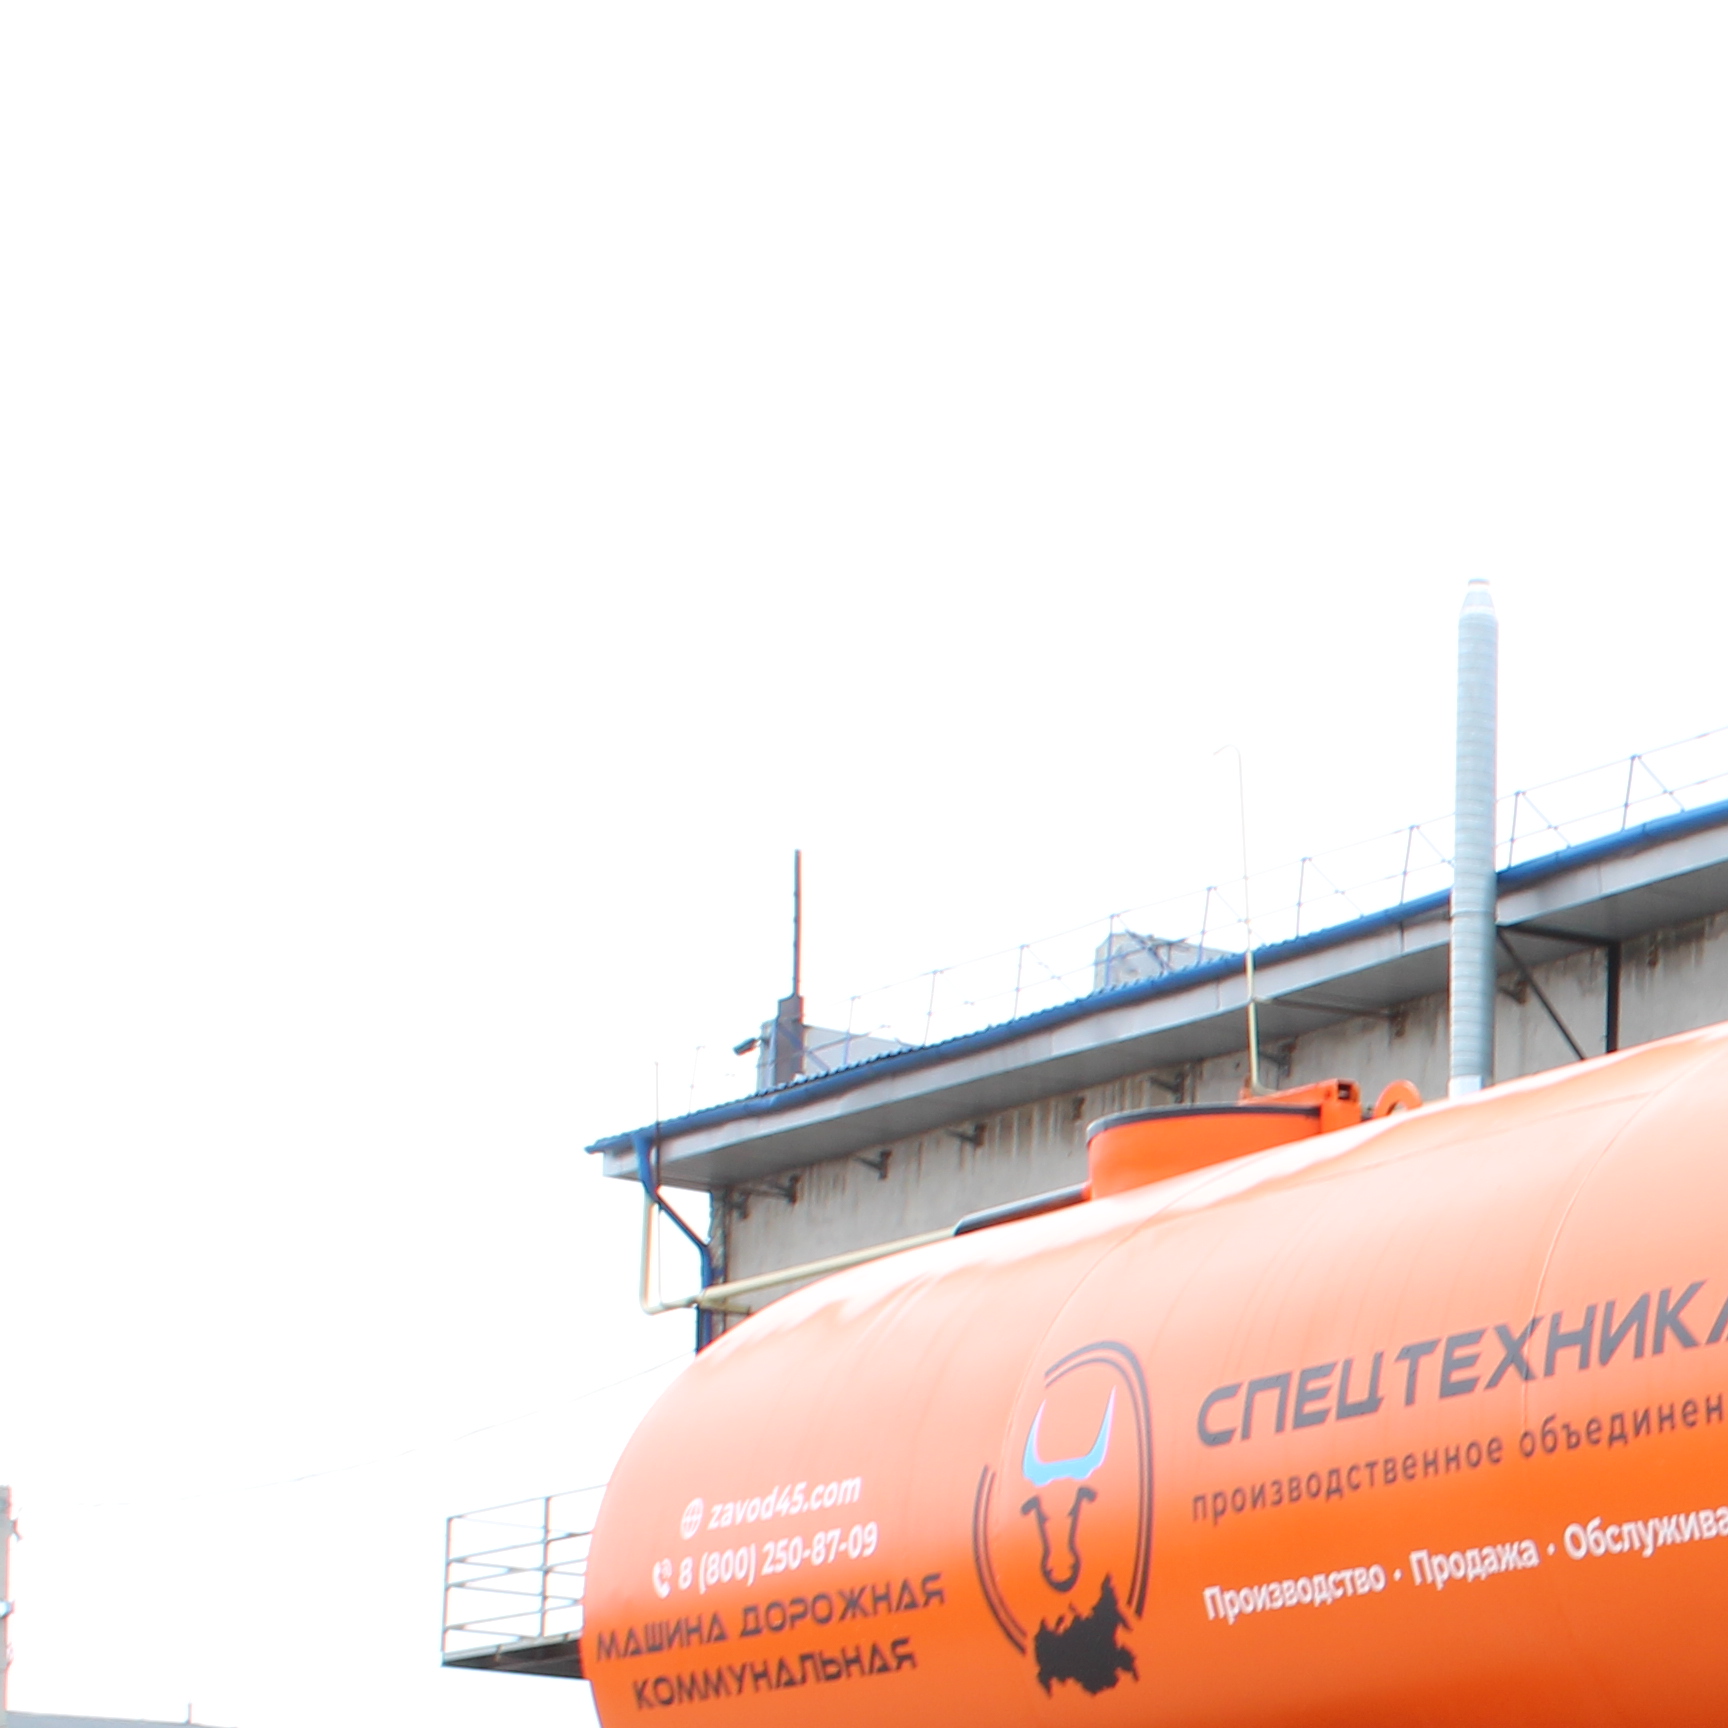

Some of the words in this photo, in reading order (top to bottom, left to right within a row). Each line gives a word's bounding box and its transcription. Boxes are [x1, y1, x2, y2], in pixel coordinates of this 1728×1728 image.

[707, 1476, 862, 1531] zavod45.com
[1192, 1435, 1503, 1527] производственное
[677, 1556, 693, 1592] 8
[699, 1542, 757, 1595] (800)
[761, 1521, 879, 1577] 250-87-09
[1203, 1563, 1387, 1626] Производство
[1409, 1538, 1540, 1591] Продажа
[596, 1610, 728, 1663] МАШИНА
[739, 1572, 946, 1638] ДОРОЖНАЯ
[632, 1636, 918, 1711] КОММУНАЛЬНАЯ
